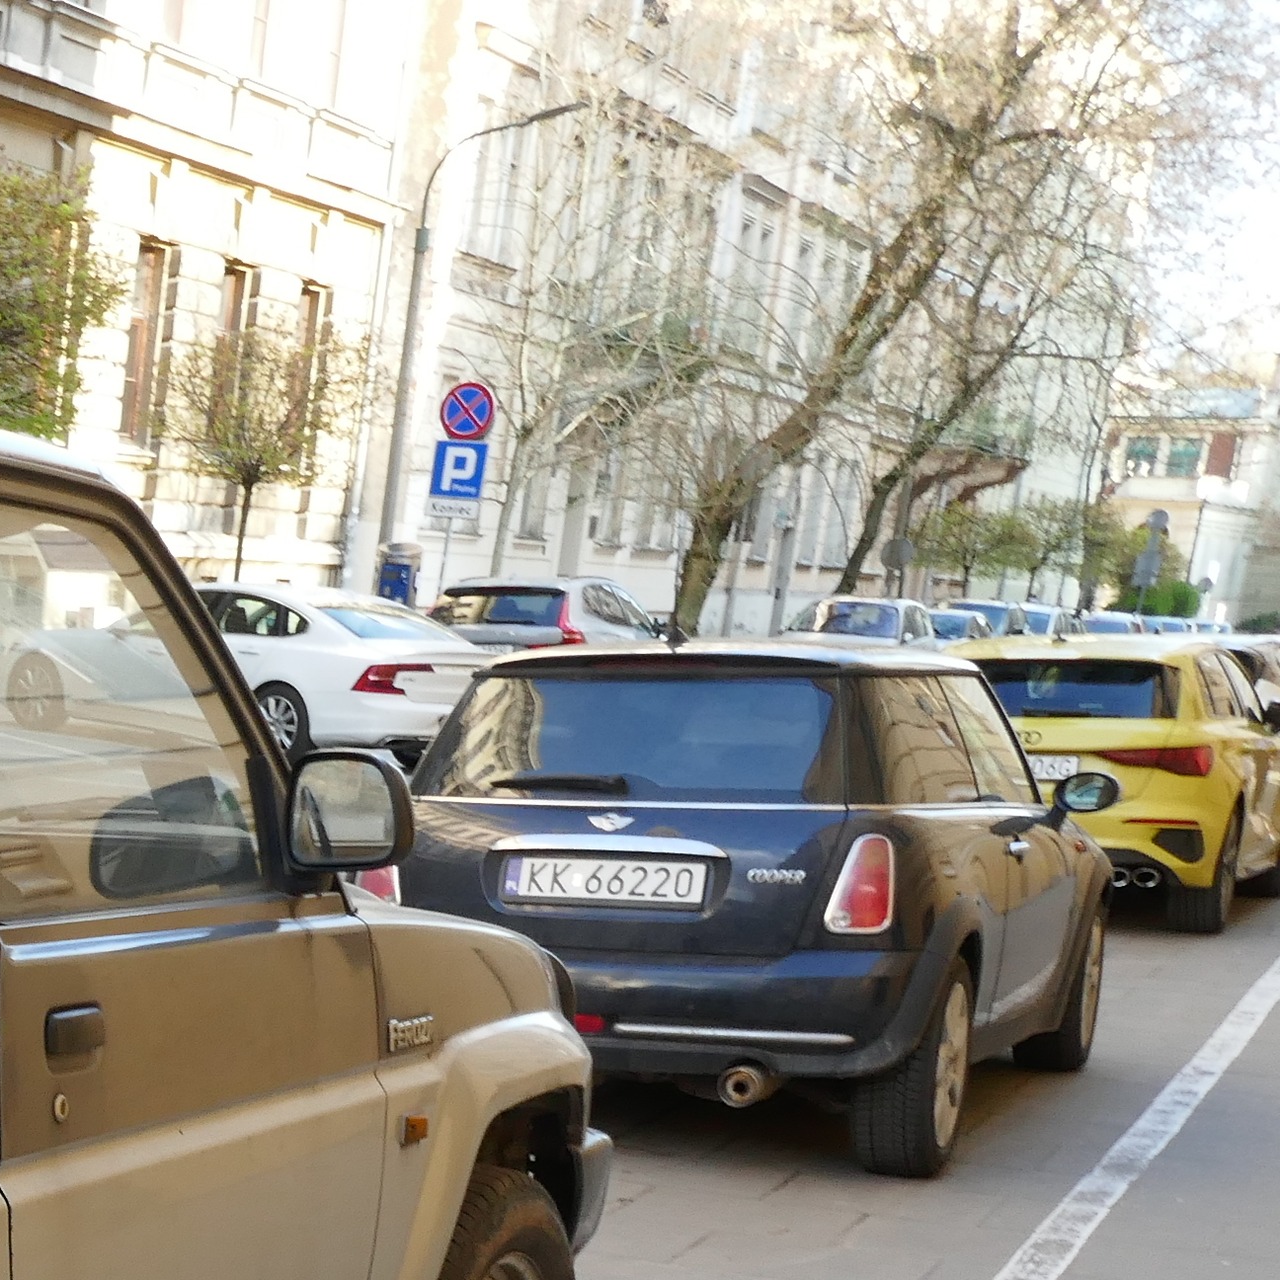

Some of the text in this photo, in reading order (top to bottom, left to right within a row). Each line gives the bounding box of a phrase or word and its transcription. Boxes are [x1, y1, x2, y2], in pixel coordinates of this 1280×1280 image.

[440, 445, 479, 492] P
[527, 863, 572, 894] KK
[584, 864, 694, 898] 66220
[746, 868, 807, 885] COOPER
